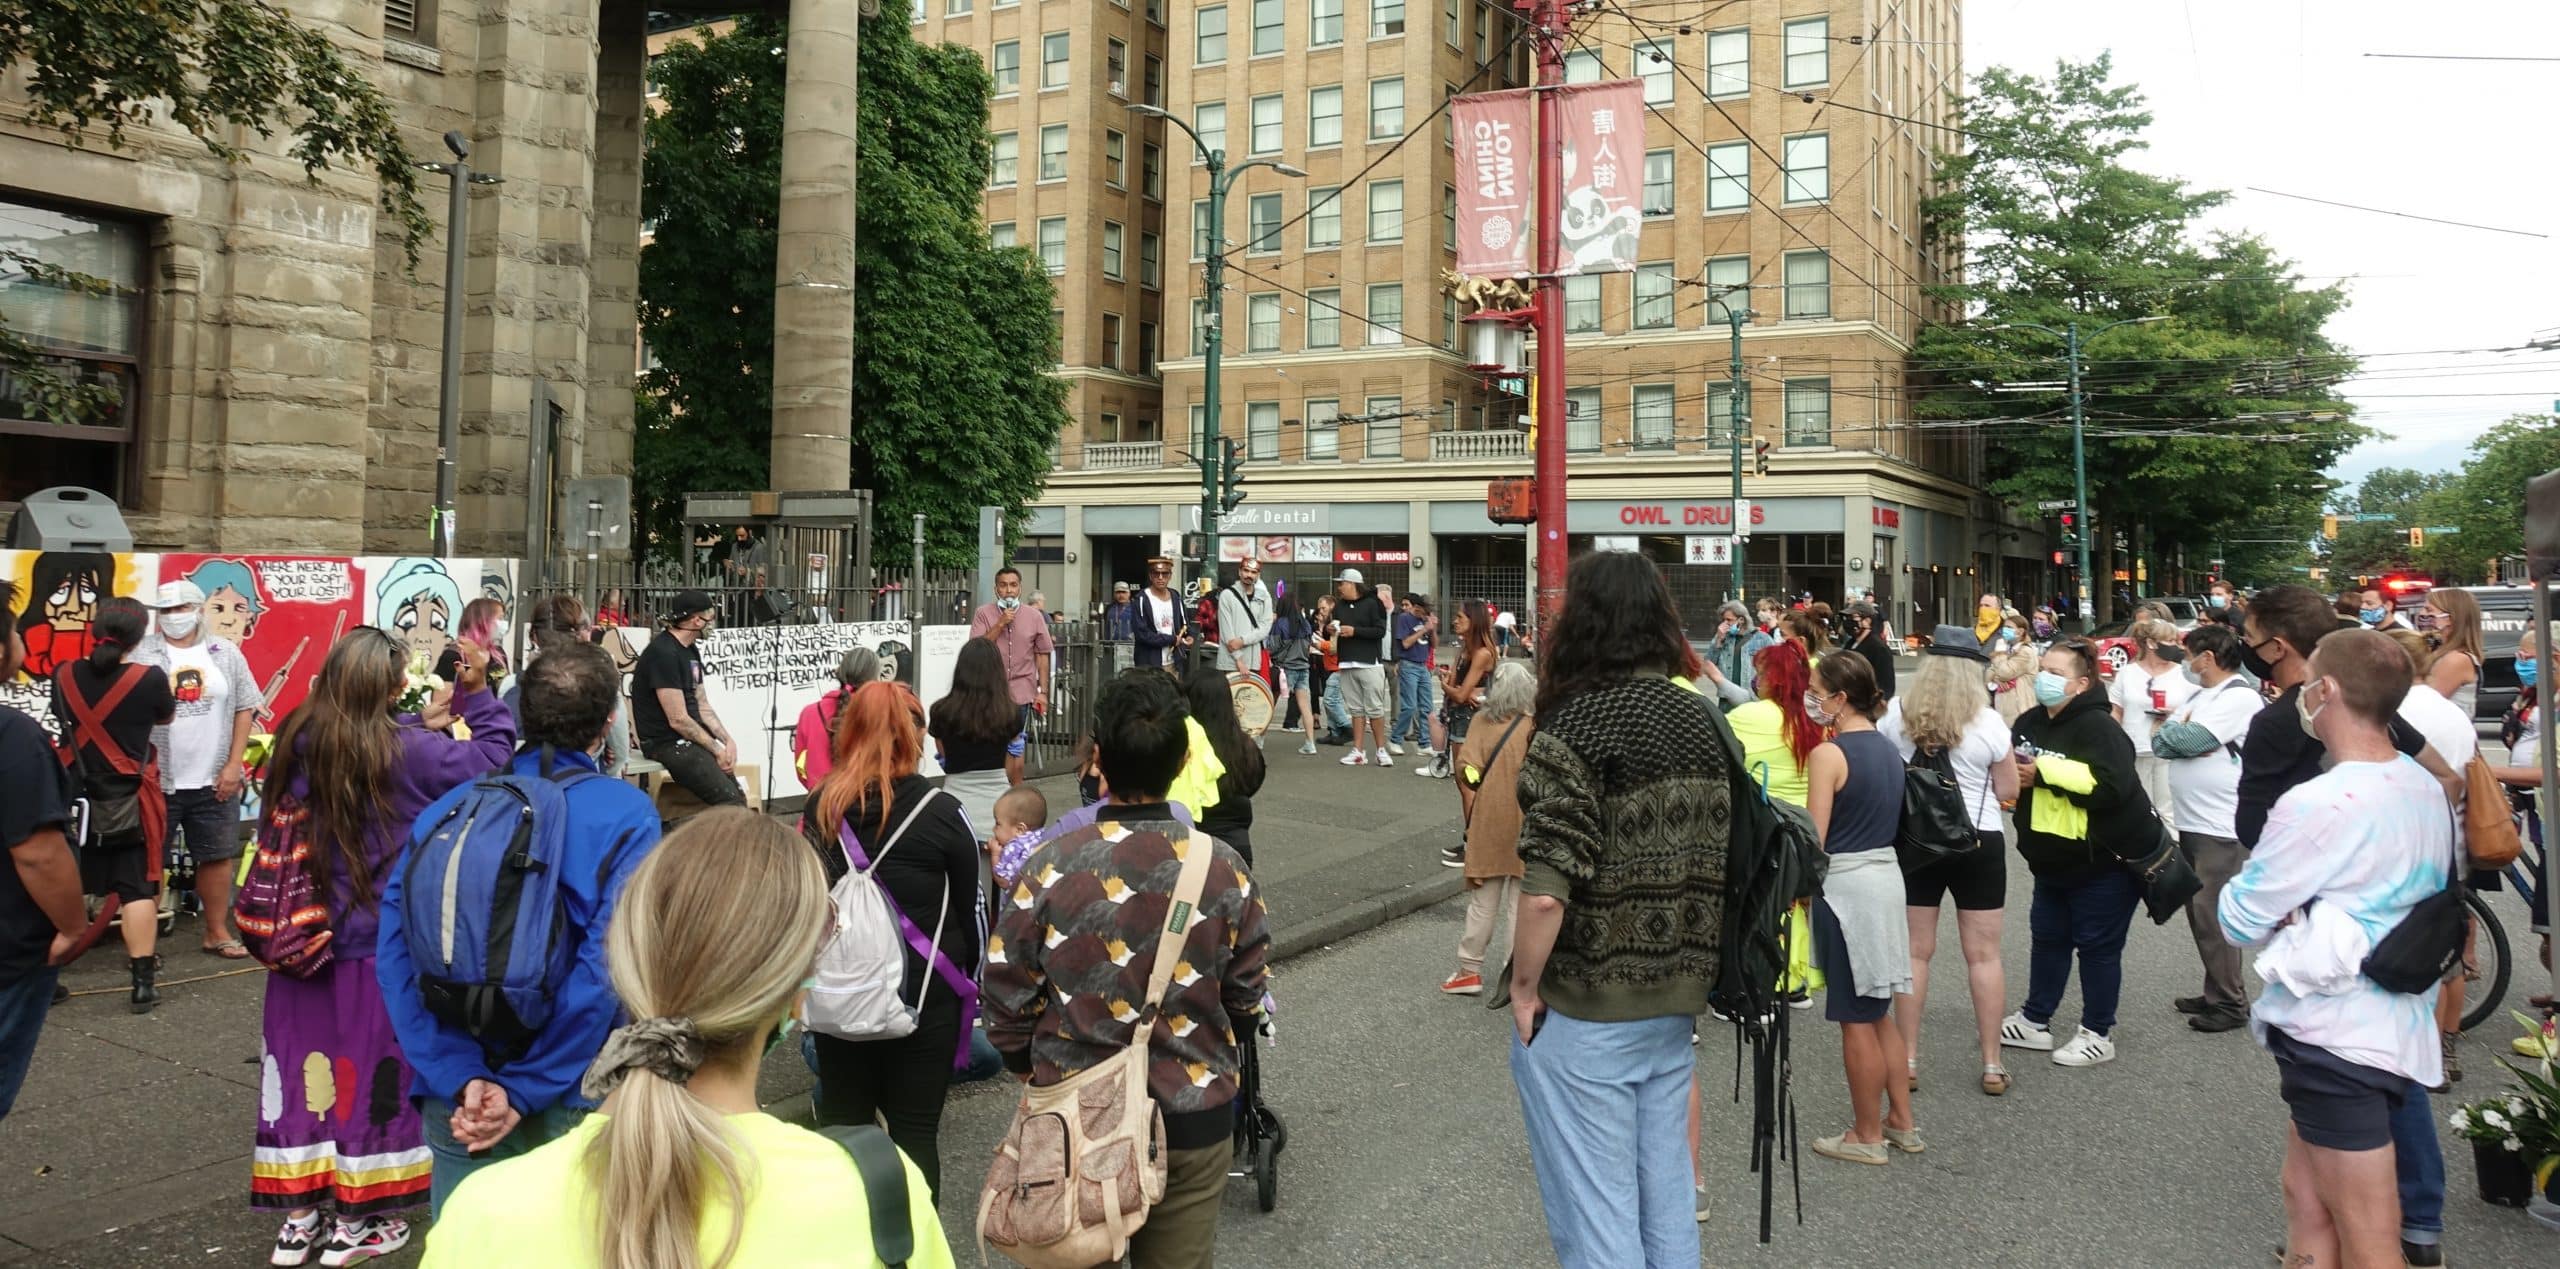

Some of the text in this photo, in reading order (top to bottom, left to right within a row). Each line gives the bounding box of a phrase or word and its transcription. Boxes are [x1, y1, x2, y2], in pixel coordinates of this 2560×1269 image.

[1264, 509, 1316, 524] Dental
[1620, 506, 1670, 525] OWL
[1683, 505, 1765, 525] DRUS
[1342, 552, 1408, 561] OWL DRUGS
[275, 573, 307, 586] YOUR
[310, 573, 344, 586] SOFT
[271, 587, 308, 599] YOUR
[852, 624, 866, 637] OF
[866, 623, 886, 637] THE
[700, 660, 743, 676] ONTHS
